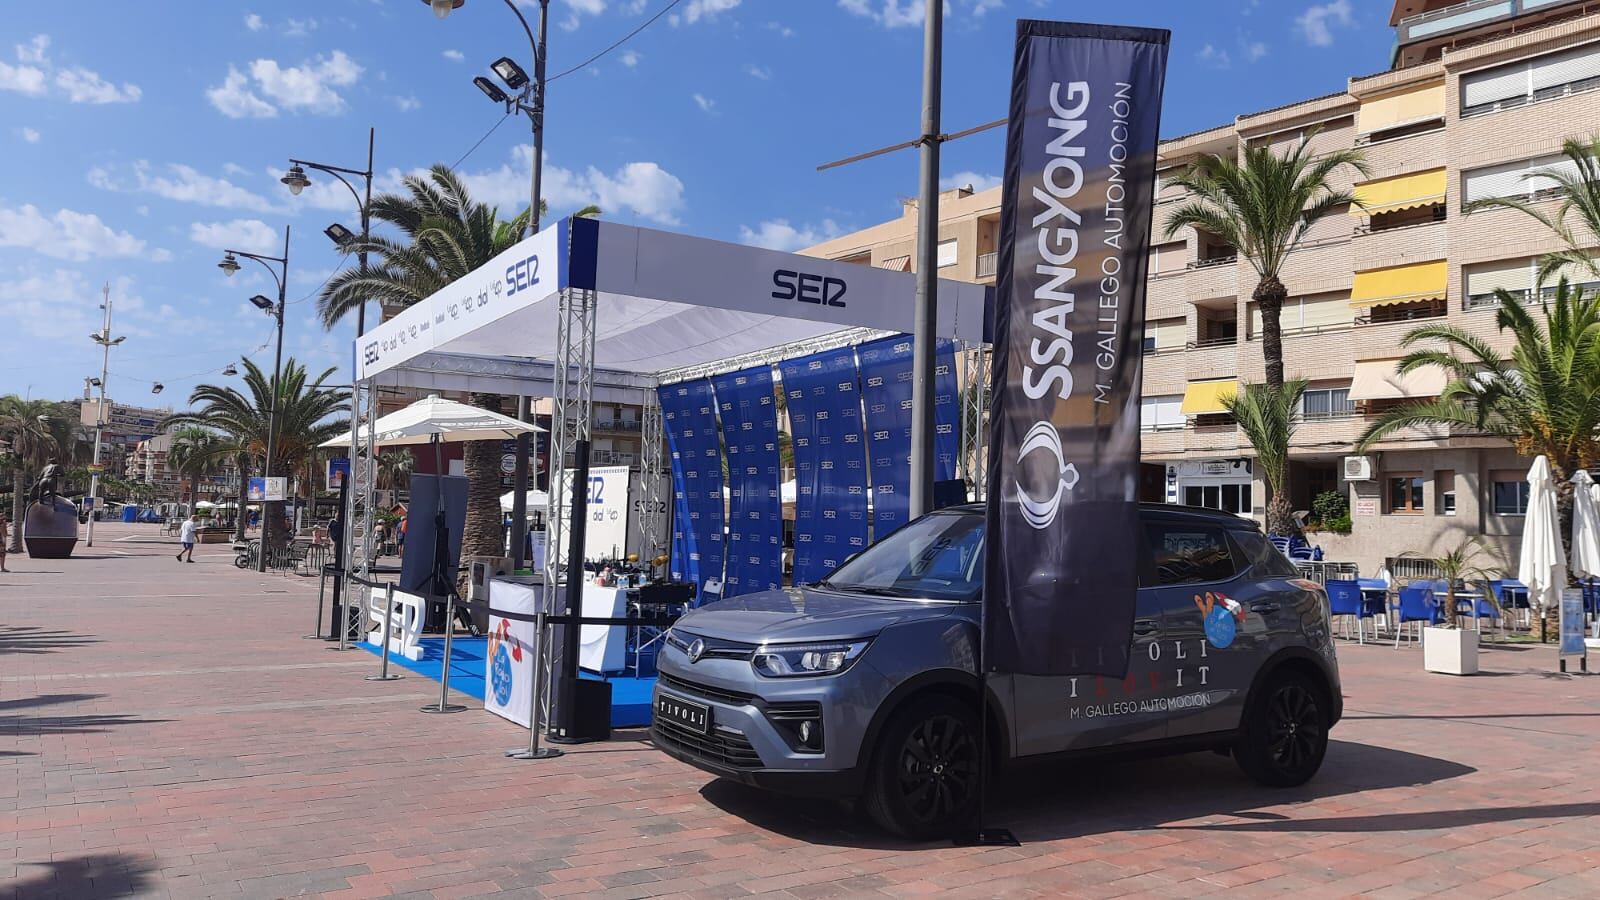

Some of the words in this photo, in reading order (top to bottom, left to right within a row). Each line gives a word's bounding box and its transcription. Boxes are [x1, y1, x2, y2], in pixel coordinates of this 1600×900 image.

[1104, 82, 1132, 250] AUTOMOCIÓN
[1022, 81, 1090, 401] SSANGYONG
[771, 269, 847, 308] SER
[365, 341, 379, 366] SER
[505, 254, 540, 297] SER
[1096, 256, 1121, 371] GALLEGO
[893, 342, 911, 354] SER
[838, 382, 853, 392] SER
[867, 376, 884, 388] SER
[1094, 379, 1113, 404] M.
[901, 399, 913, 410] SE
[816, 411, 829, 420] SER
[874, 430, 890, 441] SER
[936, 423, 953, 434] SER
[878, 484, 895, 494] SER
[823, 510, 836, 519] SER
[823, 559, 837, 568] SER
[368, 587, 426, 662] SER
[1176, 666, 1210, 687] IT
[660, 701, 704, 725] TIVOLI
[1085, 701, 1138, 718] GALLEGO
